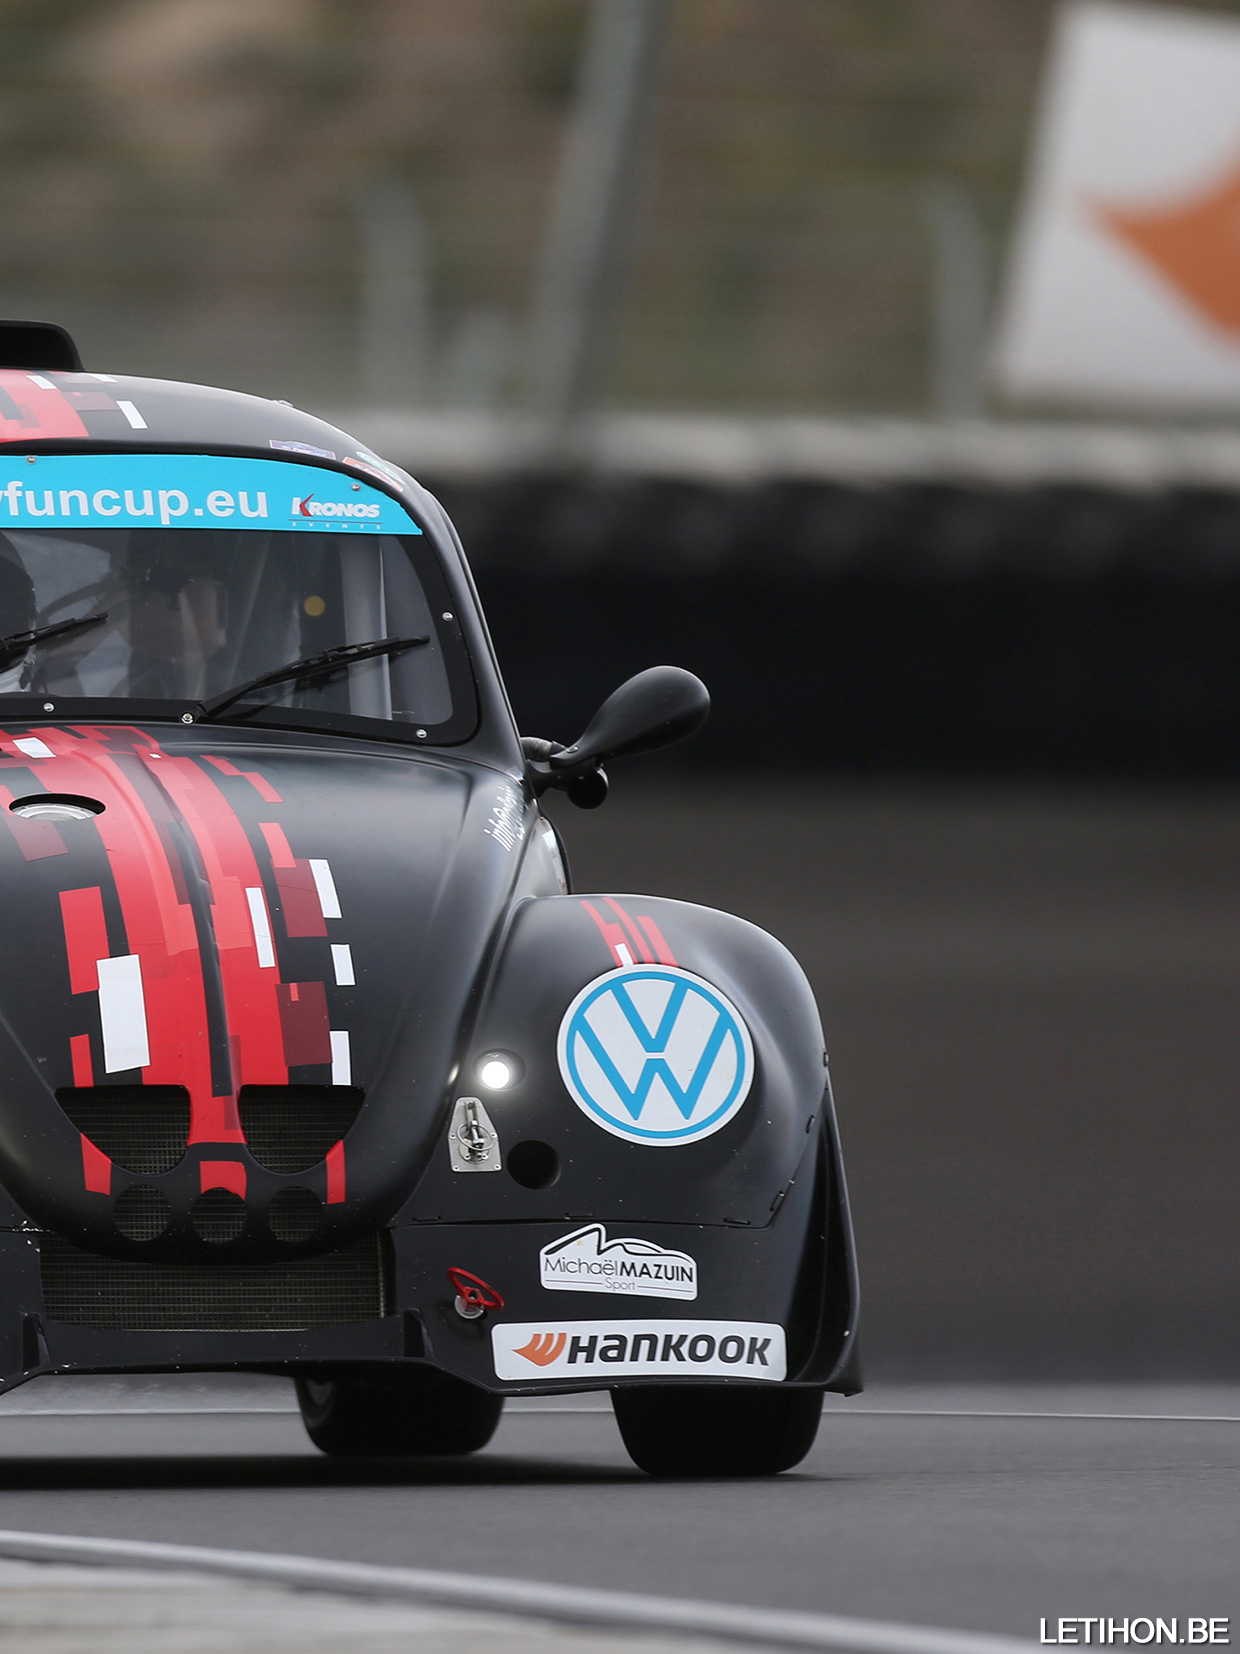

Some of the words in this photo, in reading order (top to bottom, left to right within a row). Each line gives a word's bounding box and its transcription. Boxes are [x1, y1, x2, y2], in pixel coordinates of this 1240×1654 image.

[292, 493, 381, 519] KRONOS
[292, 521, 382, 530] EVENTS
[604, 1276, 636, 1292] Sport
